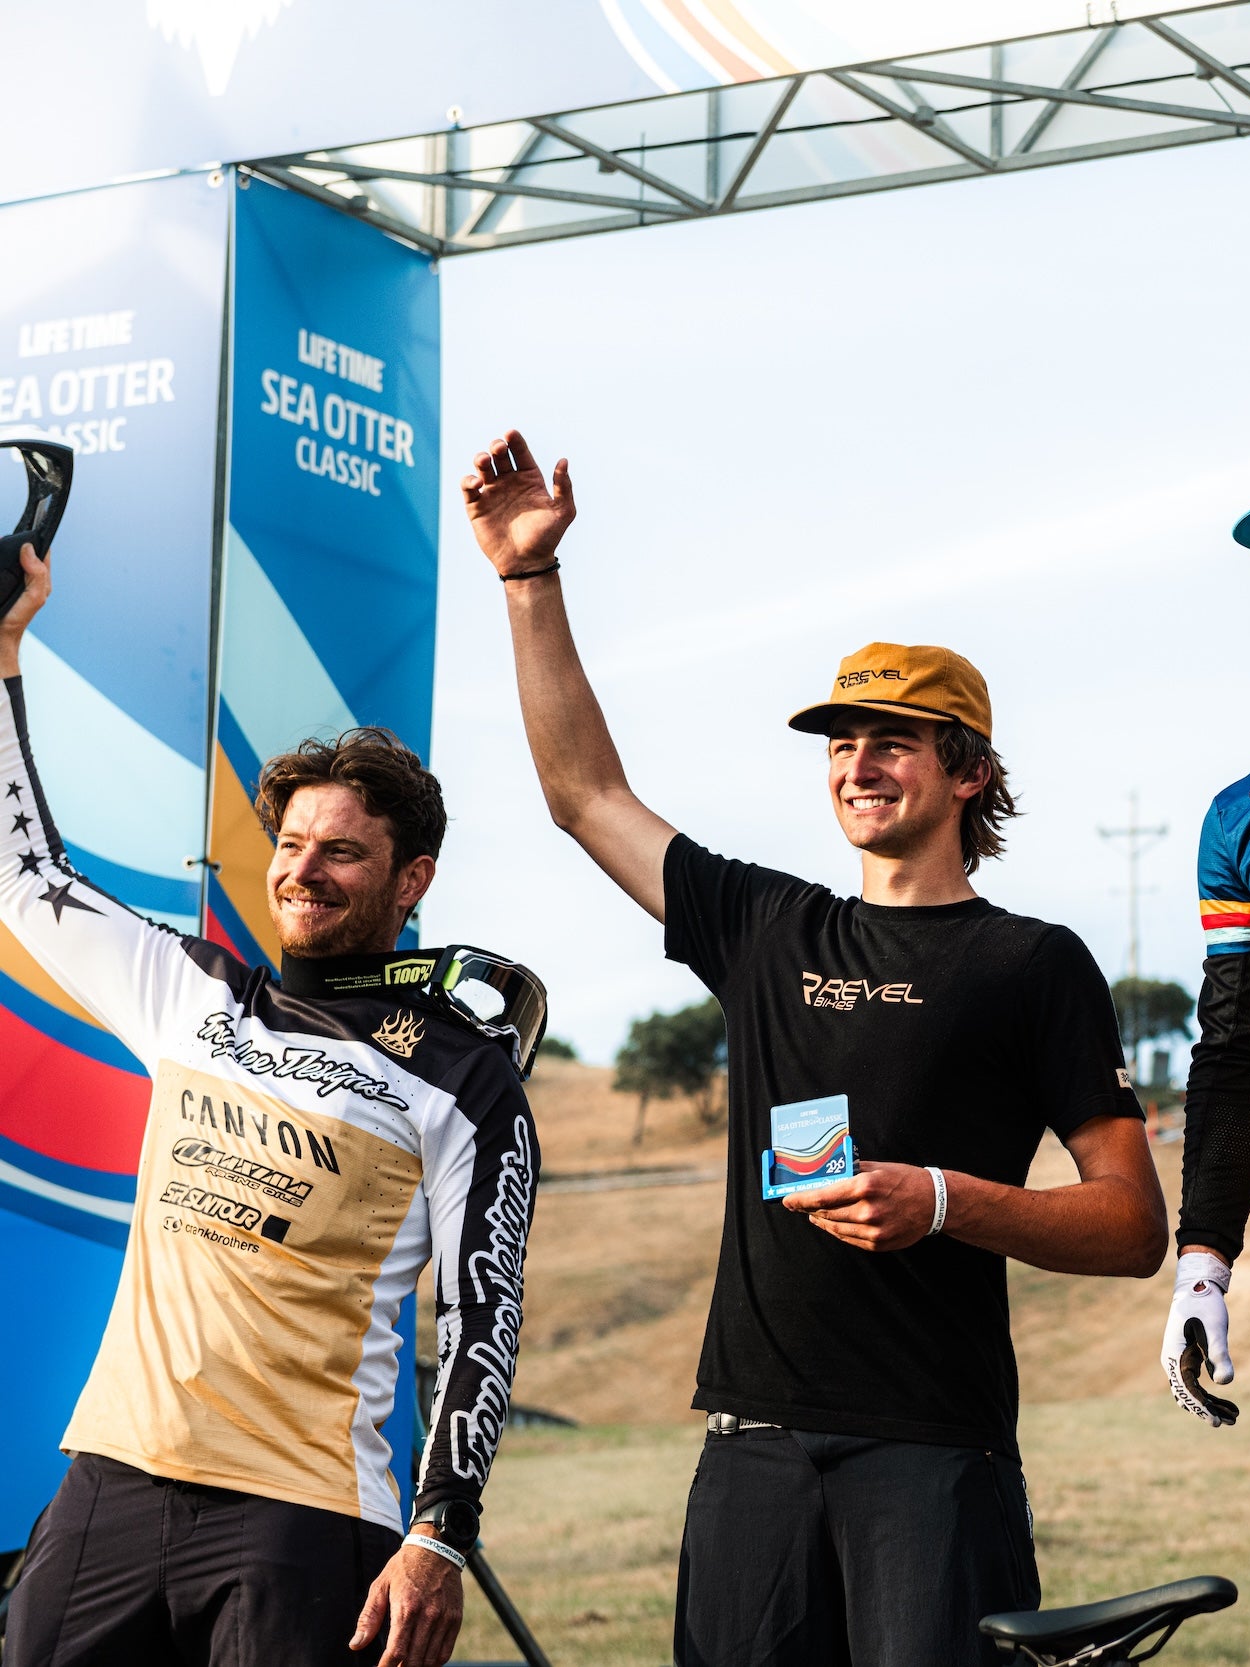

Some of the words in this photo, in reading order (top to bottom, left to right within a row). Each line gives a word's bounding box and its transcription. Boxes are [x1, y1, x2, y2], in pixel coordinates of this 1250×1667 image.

[0, 374, 43, 423] EA
[48, 357, 176, 417] OTTER
[260, 367, 320, 432] SEA
[323, 392, 415, 468] OTTER
[295, 435, 382, 498] CLASSIC
[848, 669, 909, 682] REVEL
[393, 964, 431, 985] 100%
[818, 978, 924, 1005] REVEL
[813, 996, 856, 1011] BIKES
[230, 1040, 275, 1076] Lee
[277, 1047, 410, 1112] Designs
[180, 1088, 341, 1176] CANYON
[825, 1156, 846, 1174] 2026
[160, 1181, 189, 1206] SR
[183, 1187, 262, 1231] SUNTOUR
[205, 1166, 260, 1190] RACING
[262, 1187, 305, 1207] OILS
[184, 1222, 260, 1254] crankbrothers
